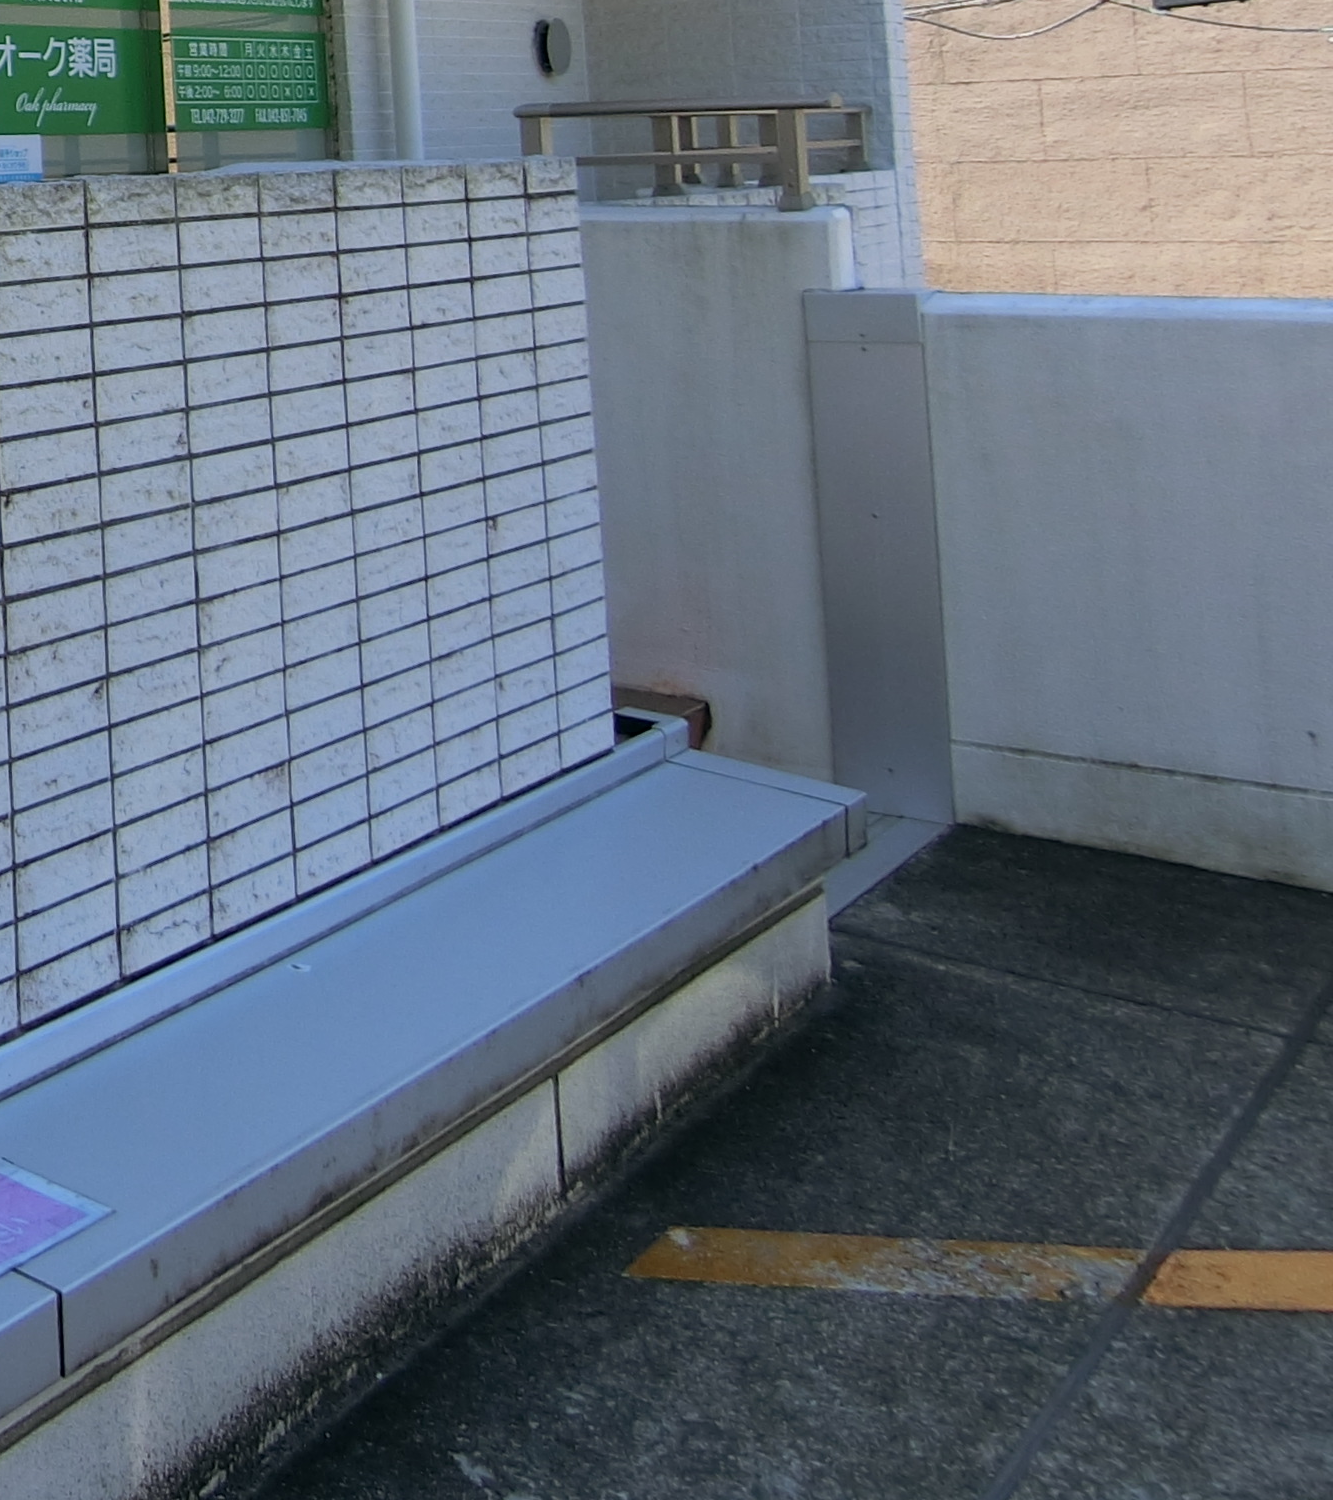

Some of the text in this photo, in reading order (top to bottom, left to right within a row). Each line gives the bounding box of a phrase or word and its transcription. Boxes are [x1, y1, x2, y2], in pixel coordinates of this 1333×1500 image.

[189, 42, 228, 57] 営業時間
[16, 87, 97, 128] Oak pharmacy
